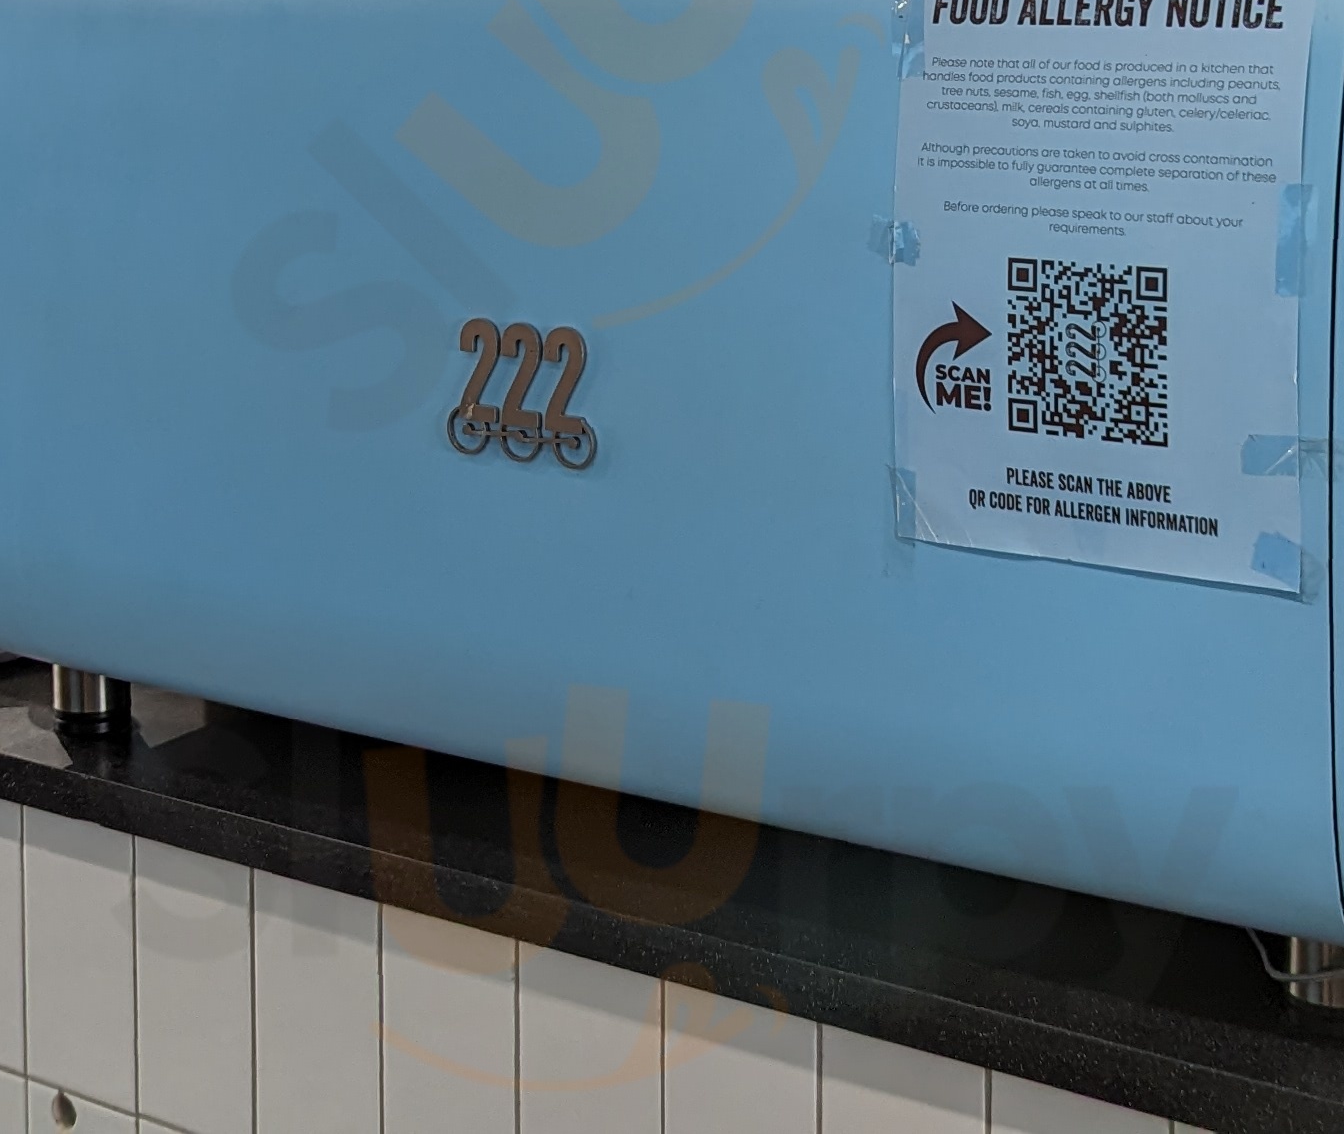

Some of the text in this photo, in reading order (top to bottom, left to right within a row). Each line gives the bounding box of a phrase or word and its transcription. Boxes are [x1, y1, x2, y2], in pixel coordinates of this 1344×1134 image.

[931, 57, 1274, 75] Please note that all of our food is produced in a kitchen that
[924, 69, 966, 82] handles
[968, 72, 994, 83] food
[996, 74, 1047, 84] products
[1049, 76, 1110, 88] containing
[1113, 76, 1167, 89] allergens
[1170, 78, 1225, 91] including
[941, 87, 964, 96] tree
[1094, 90, 1140, 101] shellfish
[1143, 91, 1174, 102] (both
[1177, 93, 1230, 104] molluscs
[1232, 95, 1257, 105] and
[1028, 104, 1069, 114] cereals
[1071, 106, 1133, 118] containing
[1043, 119, 1091, 129] mustard
[1093, 120, 1117, 130] and
[1120, 121, 1174, 132] sulphites.
[943, 201, 1243, 228] Before ordering please speak to our staff about your
[1049, 224, 1126, 236] requirements.
[459, 317, 590, 436] 222
[935, 364, 990, 386] SCAN
[936, 382, 991, 411] ME!
[1007, 468, 1171, 503] PLEASE SCAN THE ABOVE
[969, 489, 1218, 535] QR CODE FOR ALLERGEN INFORMATION
